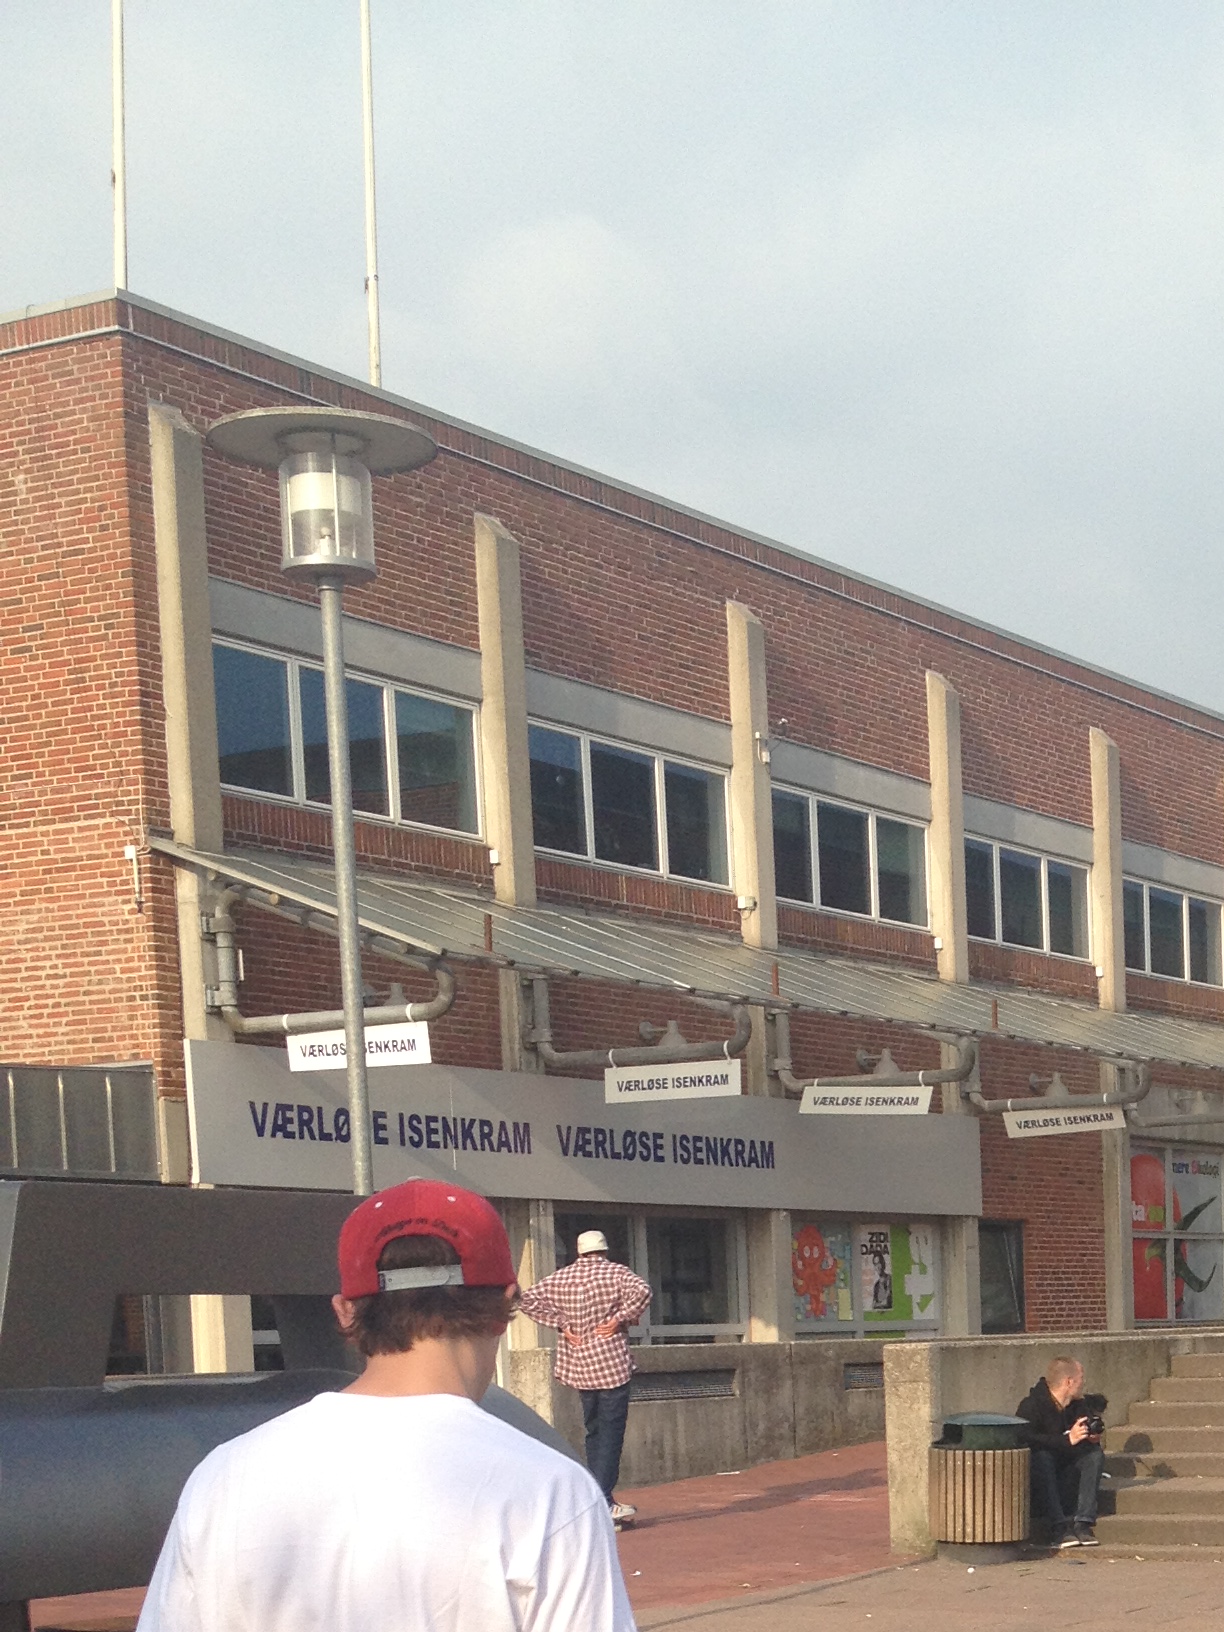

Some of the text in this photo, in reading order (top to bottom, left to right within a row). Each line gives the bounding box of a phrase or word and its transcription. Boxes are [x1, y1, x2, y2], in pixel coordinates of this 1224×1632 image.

[300, 1043, 347, 1058] VÆRLØS
[616, 1073, 729, 1093] VÆRLØSE ISENKRAM
[813, 1096, 920, 1107] VÆRLØSE ISENKRAM
[248, 1100, 532, 1154] VÆRLØE ISENKRAM
[1015, 1112, 1115, 1130] VÆRLØSE ISENKRAM
[556, 1124, 776, 1170] VÆRLØSE ISENKRAM
